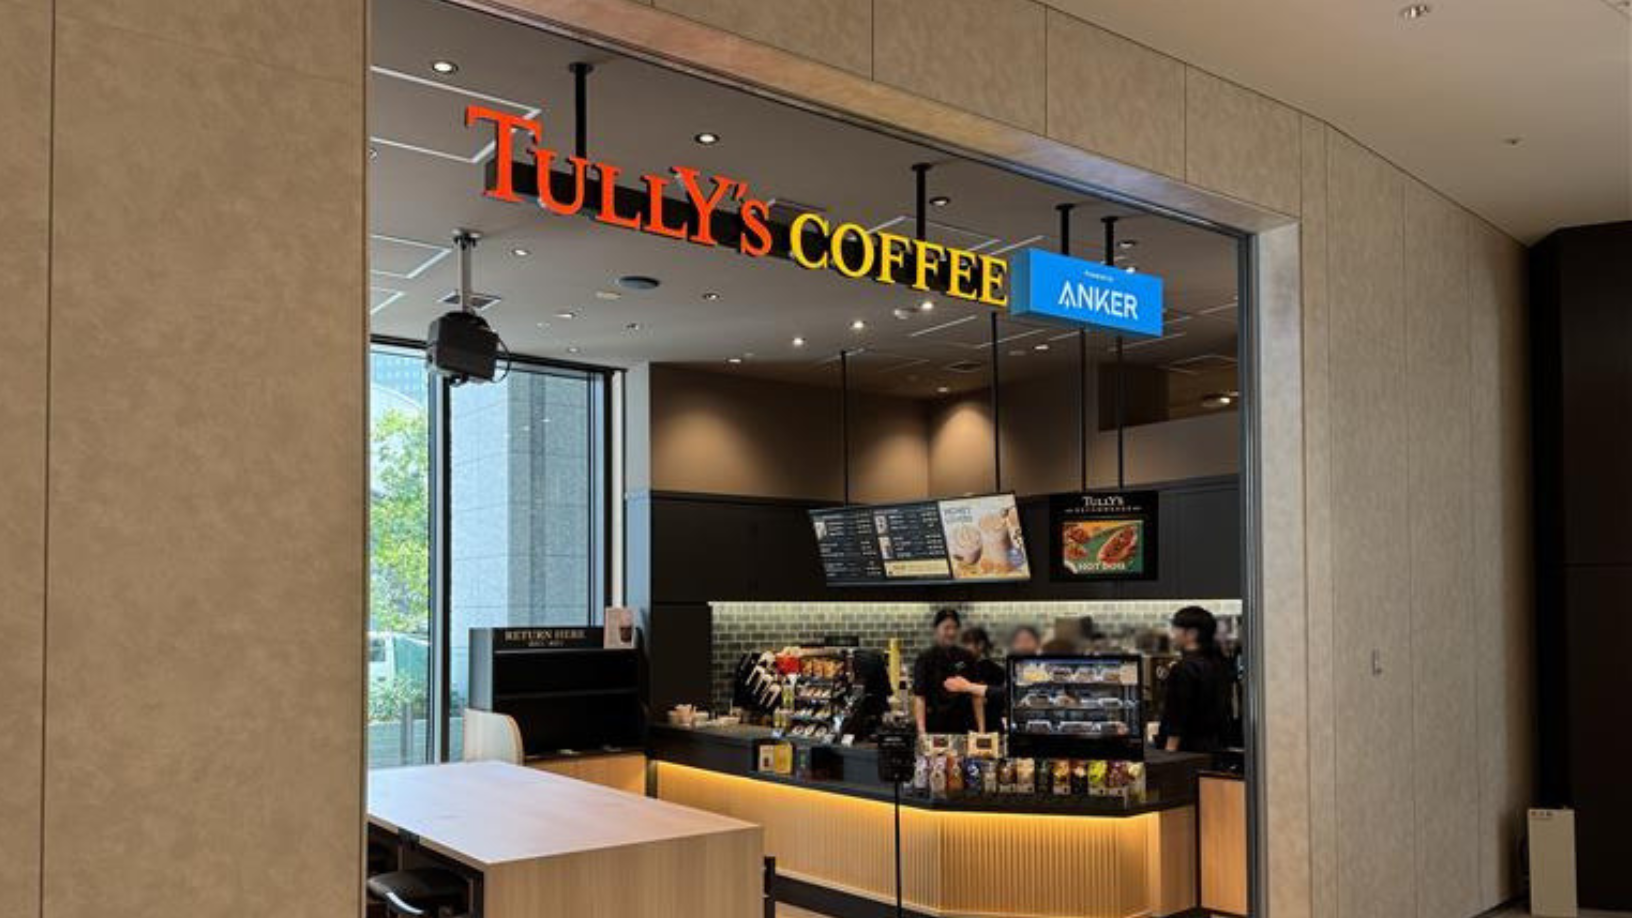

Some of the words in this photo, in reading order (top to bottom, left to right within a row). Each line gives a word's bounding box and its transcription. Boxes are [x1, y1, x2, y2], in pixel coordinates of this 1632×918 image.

[789, 213, 1008, 306] COFFEE
[1058, 280, 1138, 320] ANKER
[505, 630, 552, 641] RETURN
